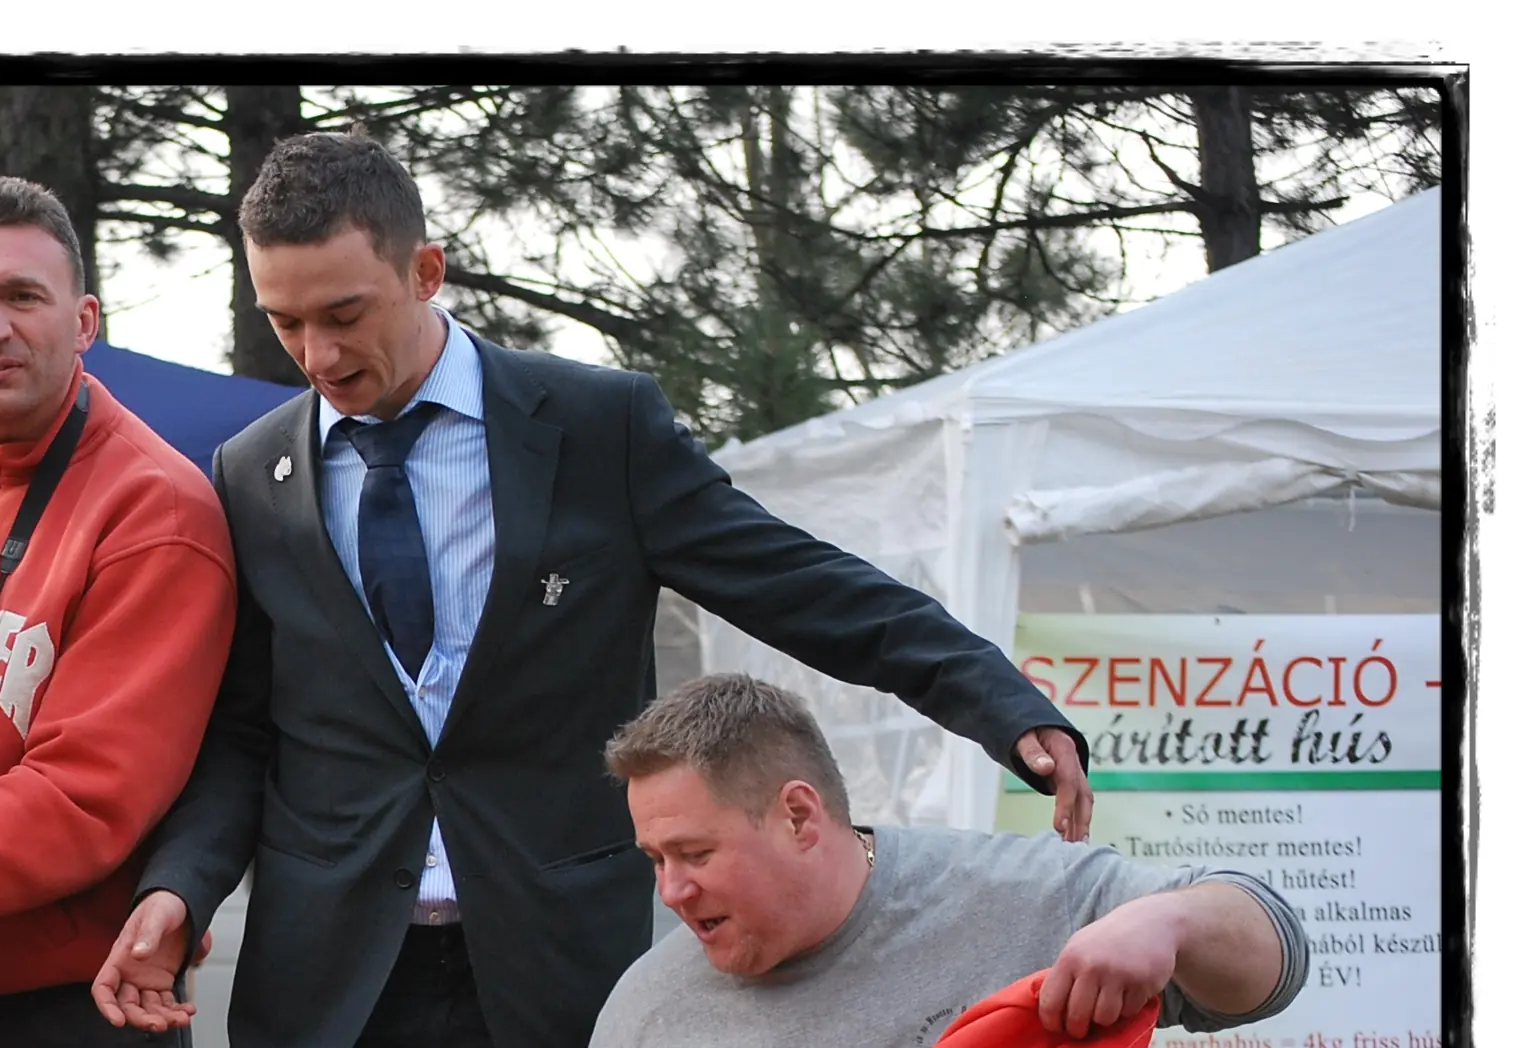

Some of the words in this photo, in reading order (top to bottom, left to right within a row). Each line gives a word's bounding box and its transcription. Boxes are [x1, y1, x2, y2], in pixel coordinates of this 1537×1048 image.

[1021, 639, 1399, 709] SZENZÁCIÓ
[1291, 708, 1394, 765] hús
[1181, 804, 1210, 824] Só
[1217, 804, 1304, 824] mentes!
[1277, 836, 1364, 858] mentes!
[1314, 901, 1413, 922] alkalmas
[1306, 933, 1366, 955] hából
[1319, 961, 1362, 988] ÉV!
